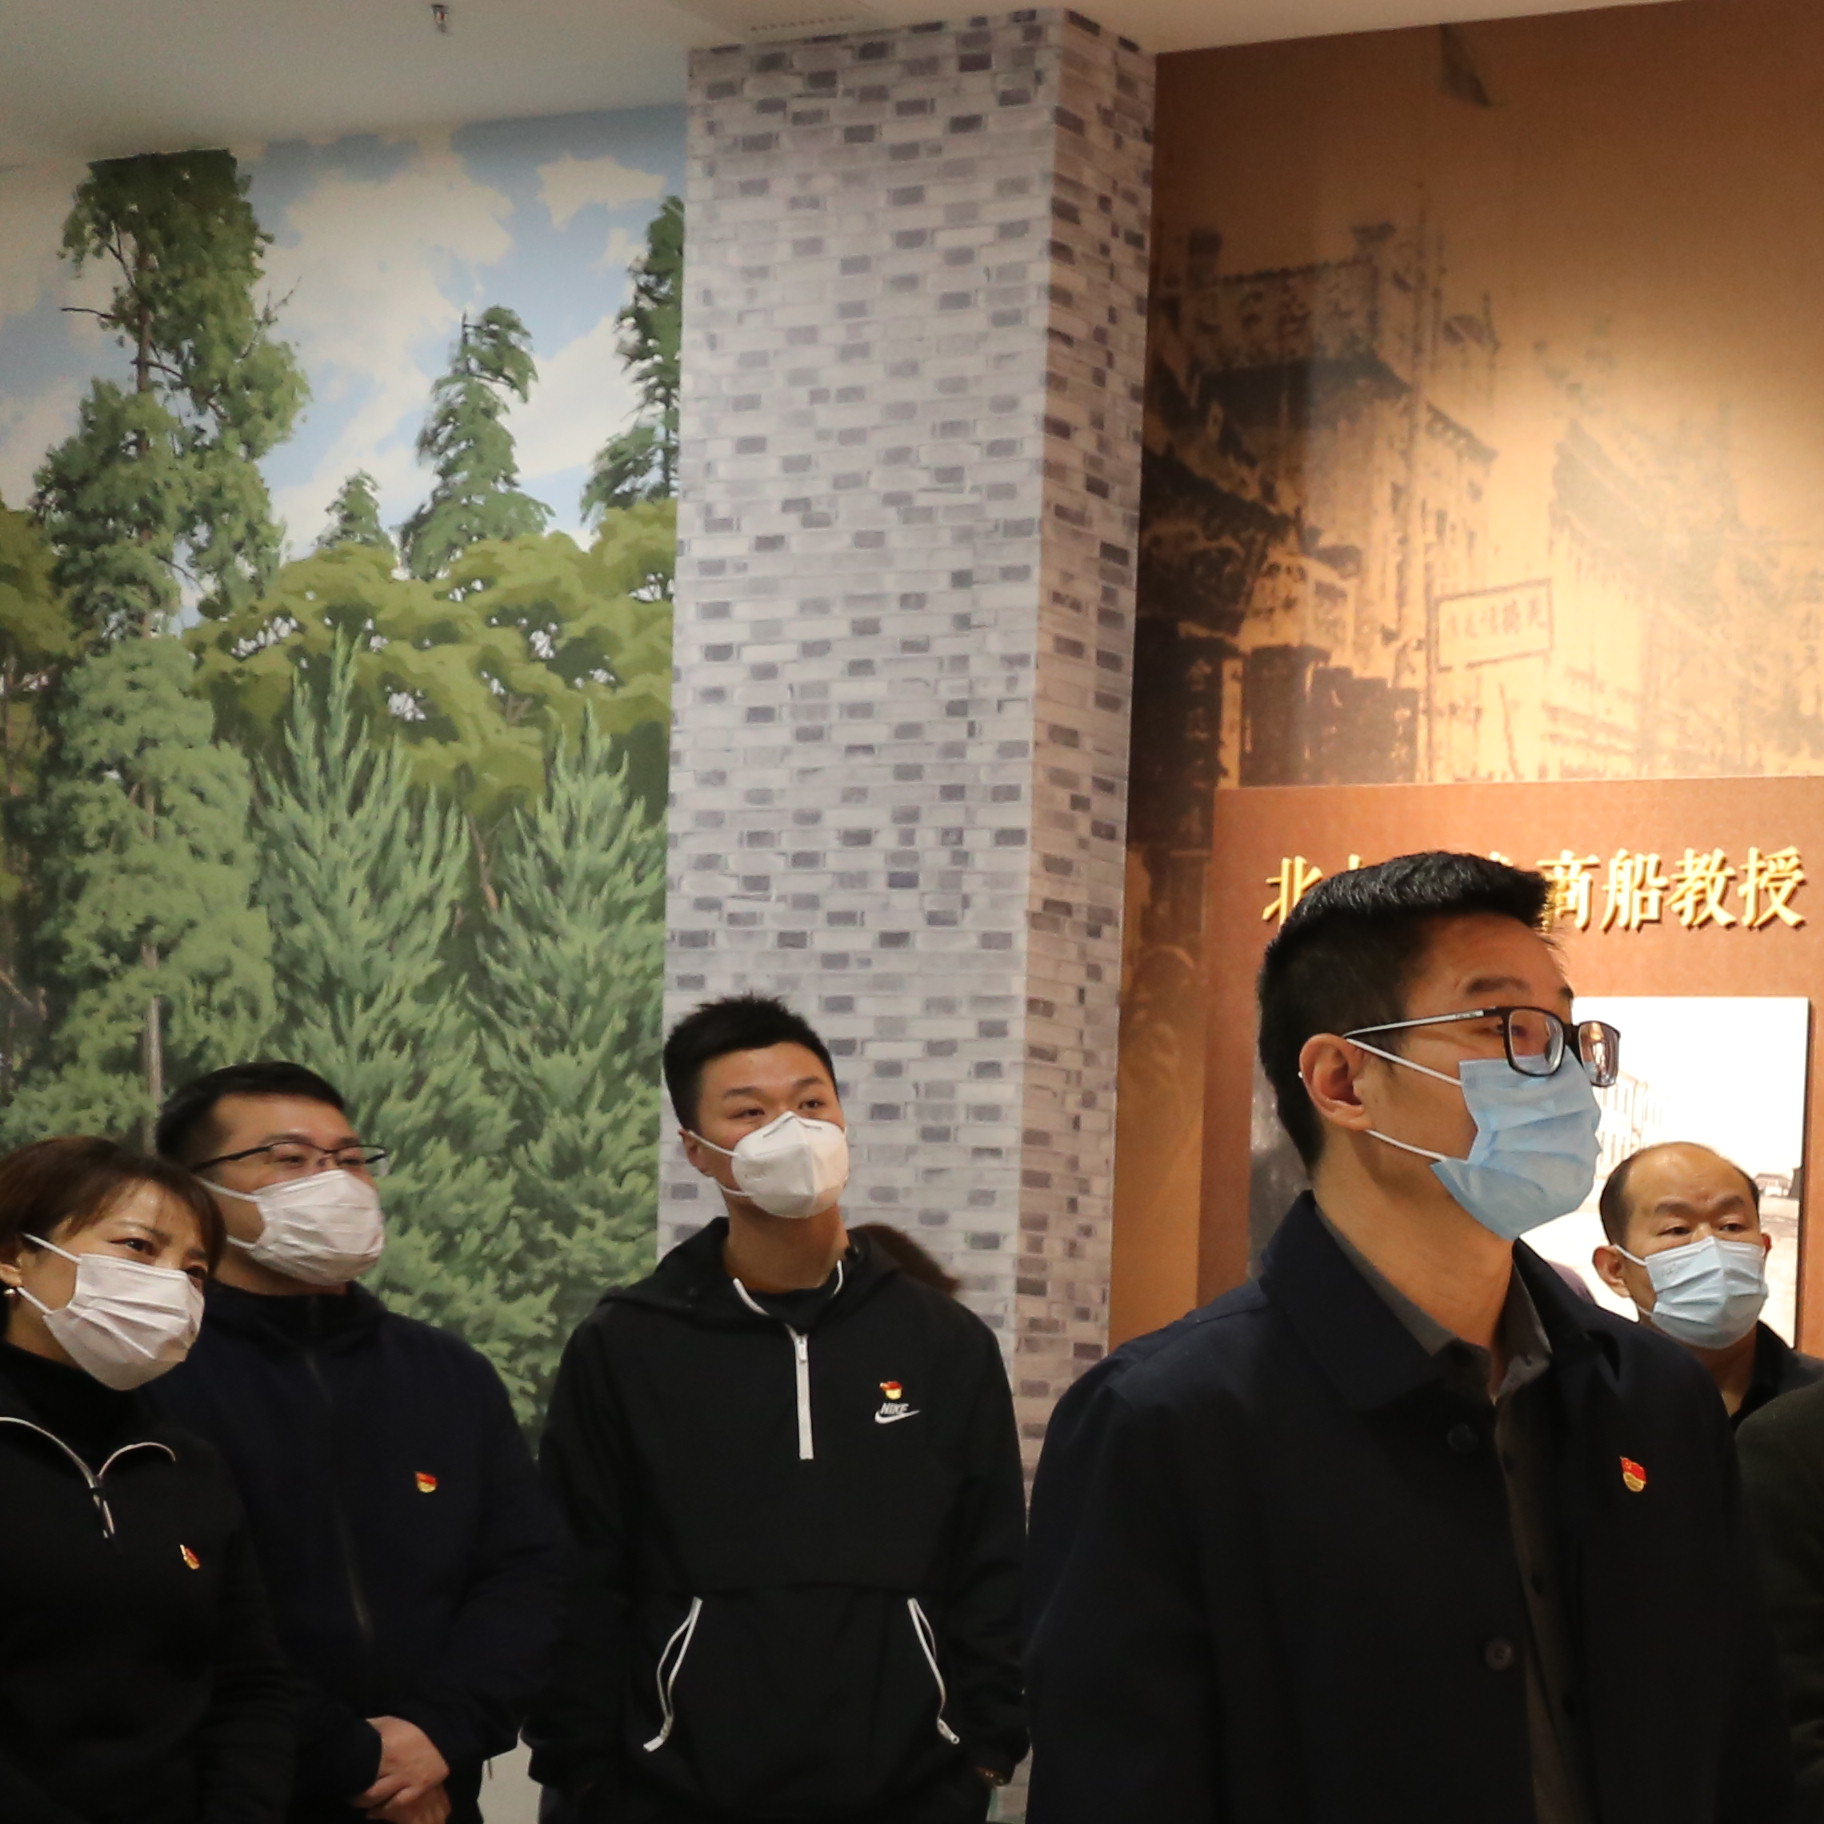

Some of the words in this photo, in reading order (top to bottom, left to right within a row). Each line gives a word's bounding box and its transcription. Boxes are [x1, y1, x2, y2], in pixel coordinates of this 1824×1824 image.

[1535, 846, 1807, 932] 商船教授
[881, 1402, 909, 1414] NIKE
